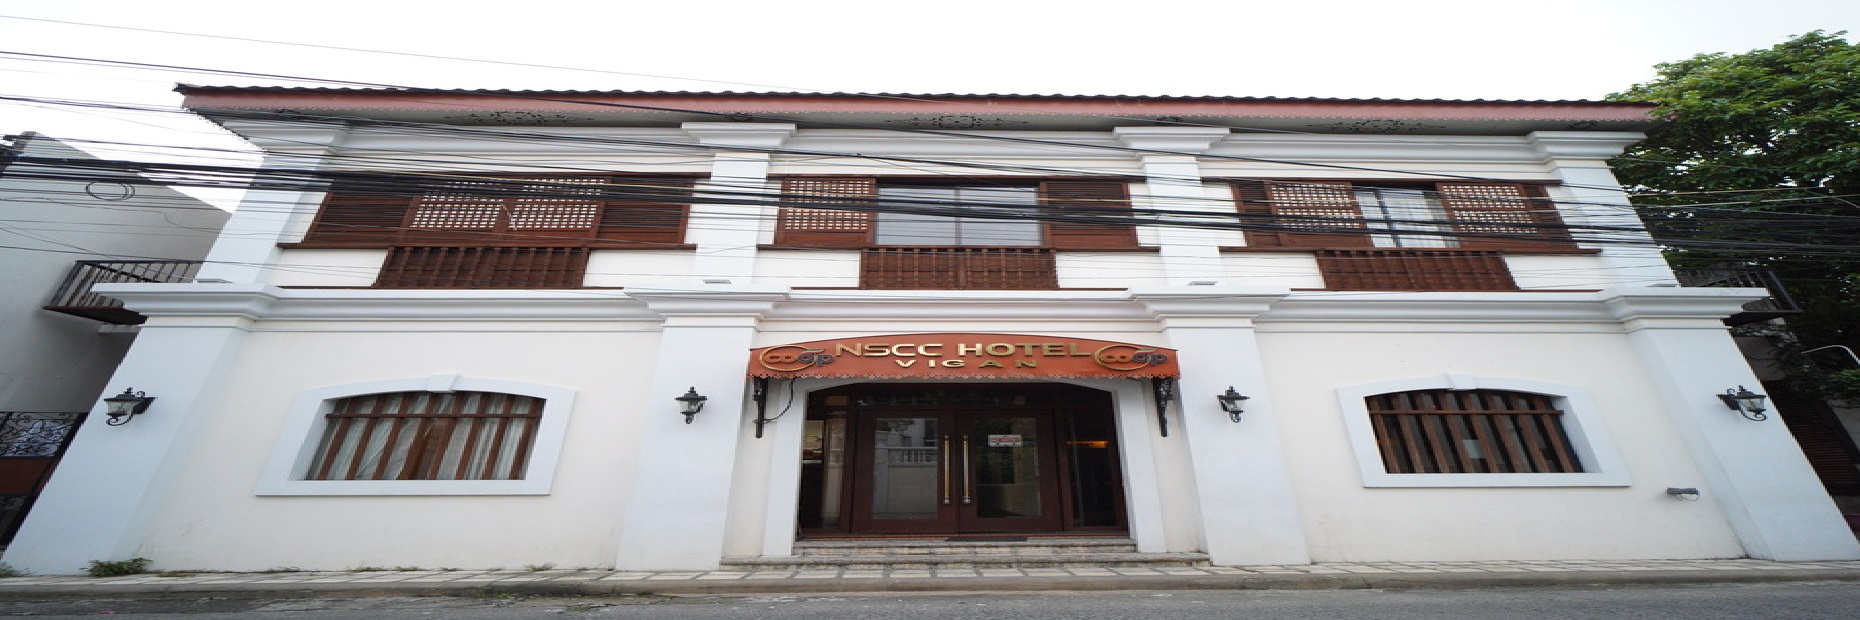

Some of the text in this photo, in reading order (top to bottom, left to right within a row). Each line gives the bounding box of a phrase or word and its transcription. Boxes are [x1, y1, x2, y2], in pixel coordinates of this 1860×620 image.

[836, 342, 1092, 358] NSCC HOTEL
[895, 359, 1037, 369] VIGAN
